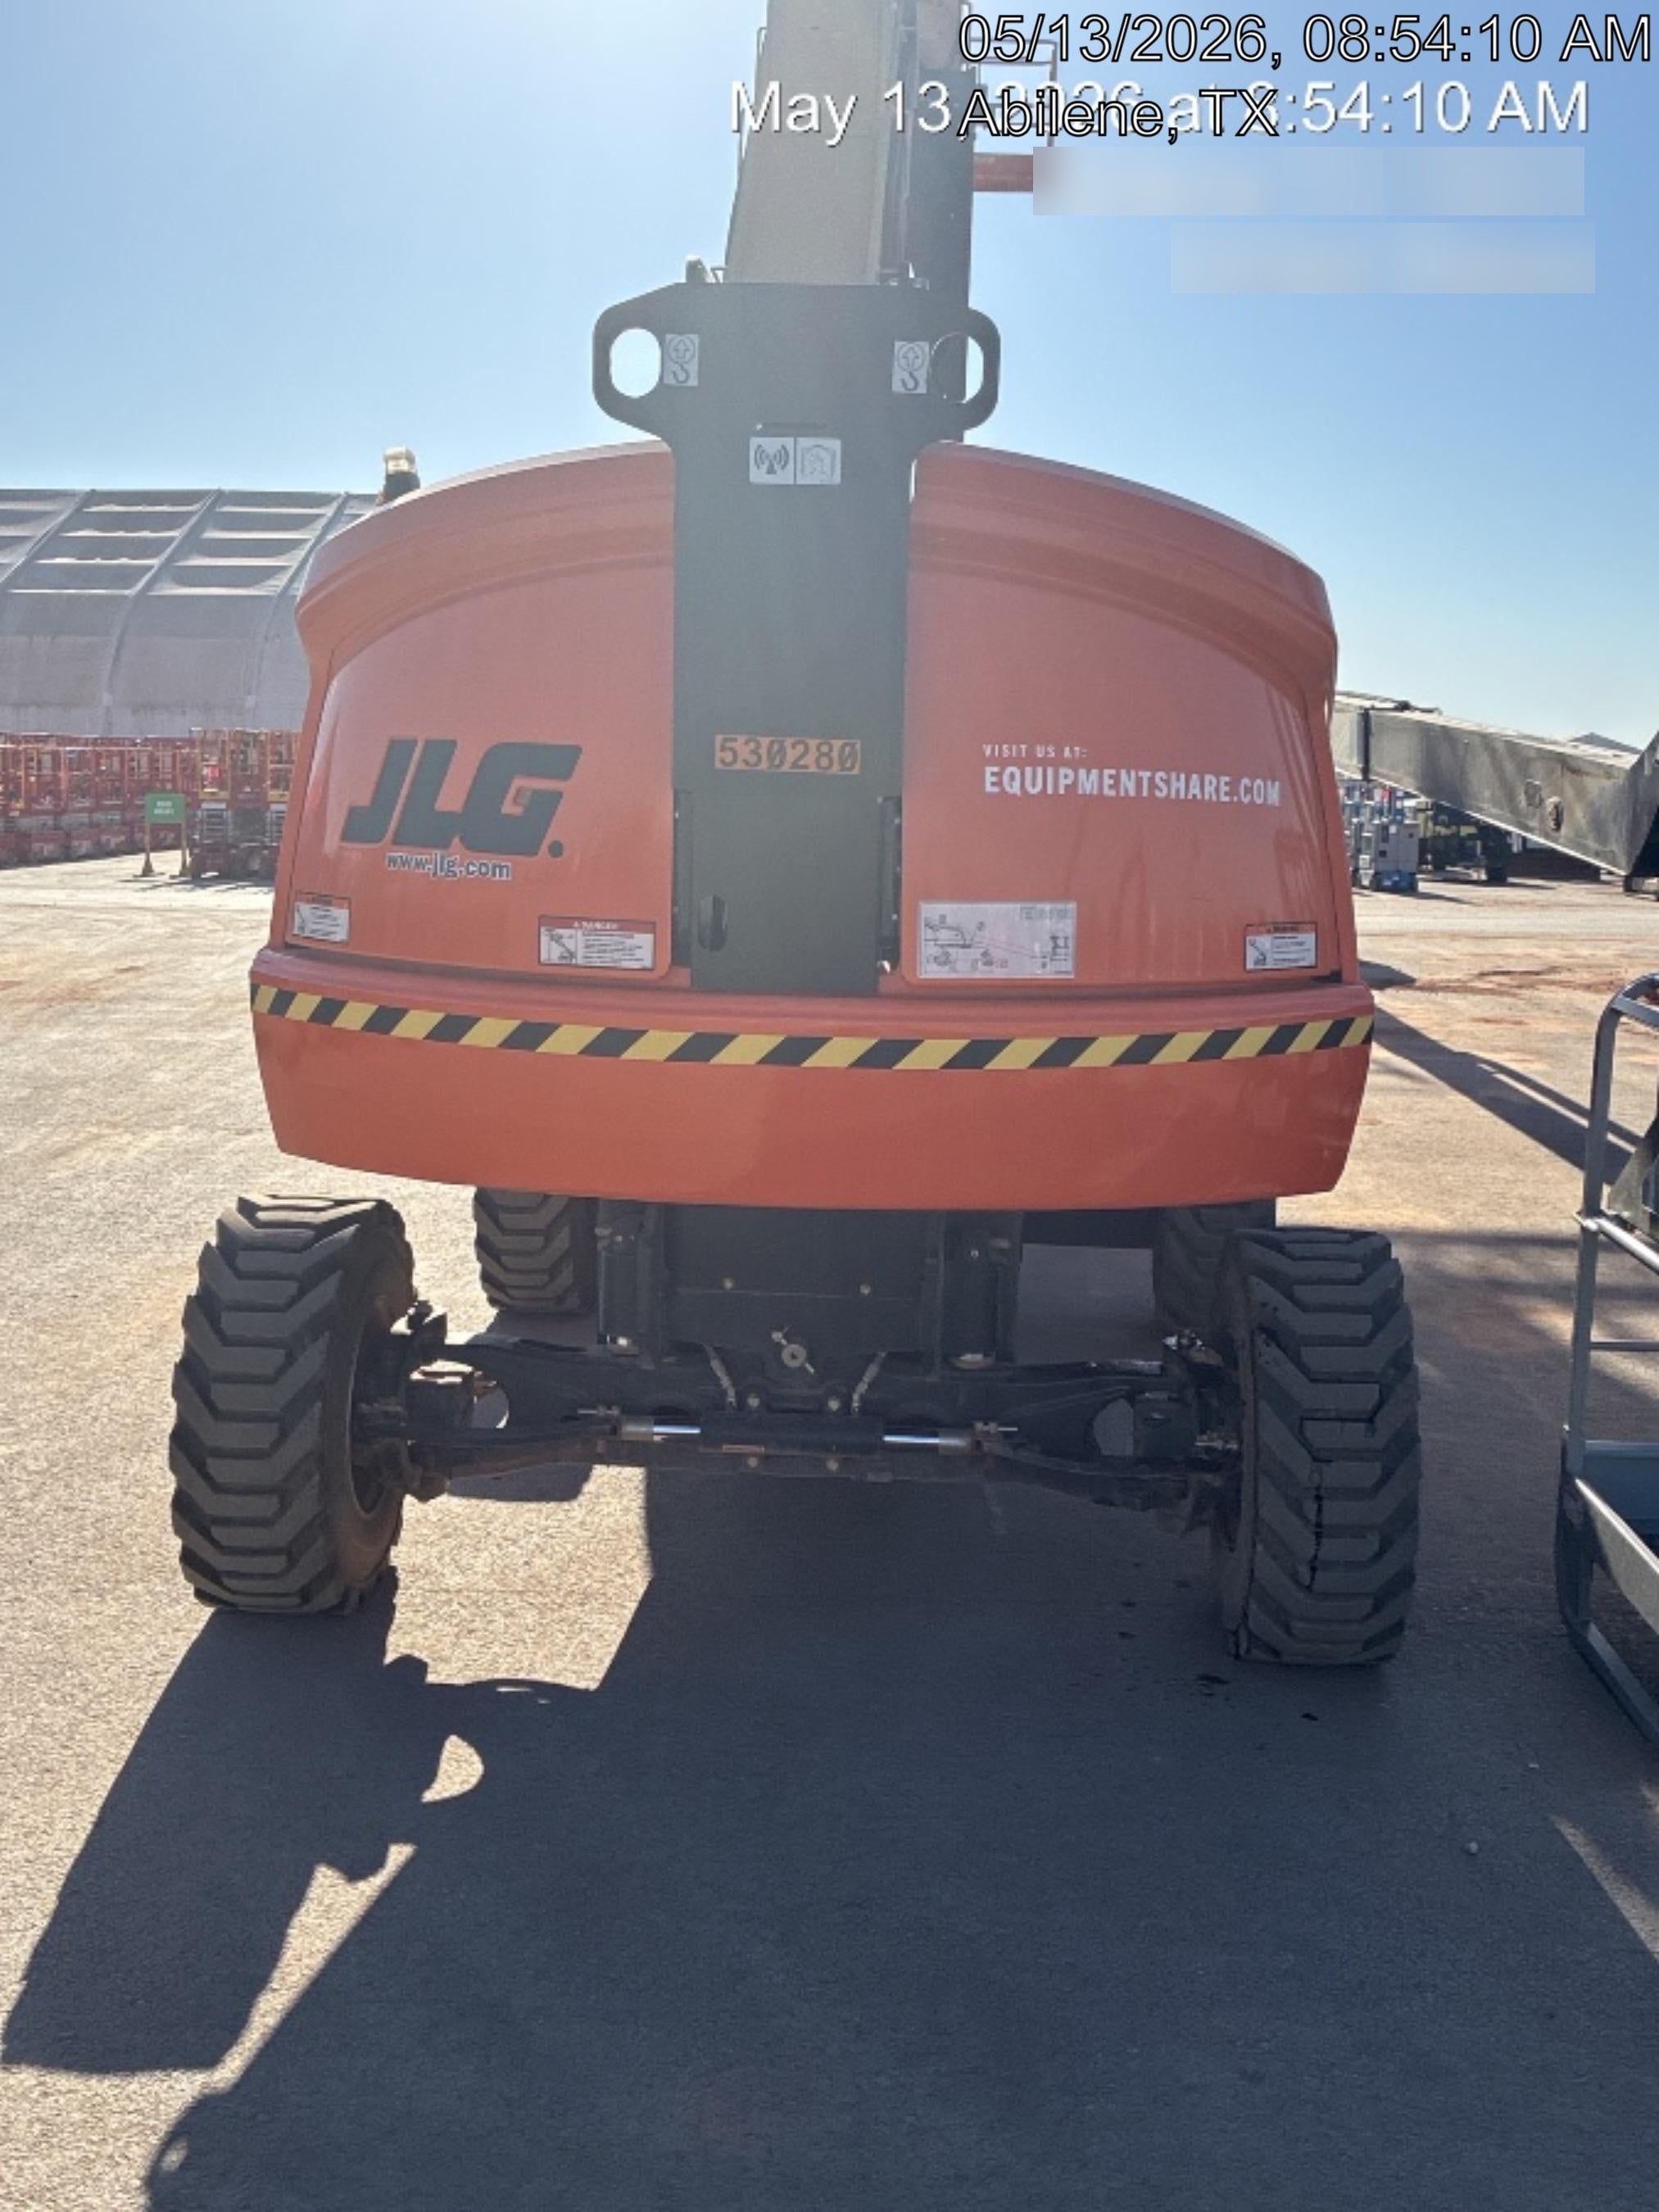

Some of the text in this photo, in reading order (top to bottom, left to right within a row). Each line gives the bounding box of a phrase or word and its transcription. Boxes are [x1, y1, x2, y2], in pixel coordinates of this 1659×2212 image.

[719, 737, 859, 772] 530280
[983, 744, 1028, 759] VISIT
[1036, 744, 1056, 759] US
[984, 765, 1281, 806] EQUIPMENTSHARE.COM
[387, 850, 511, 880] www.jlg.com
